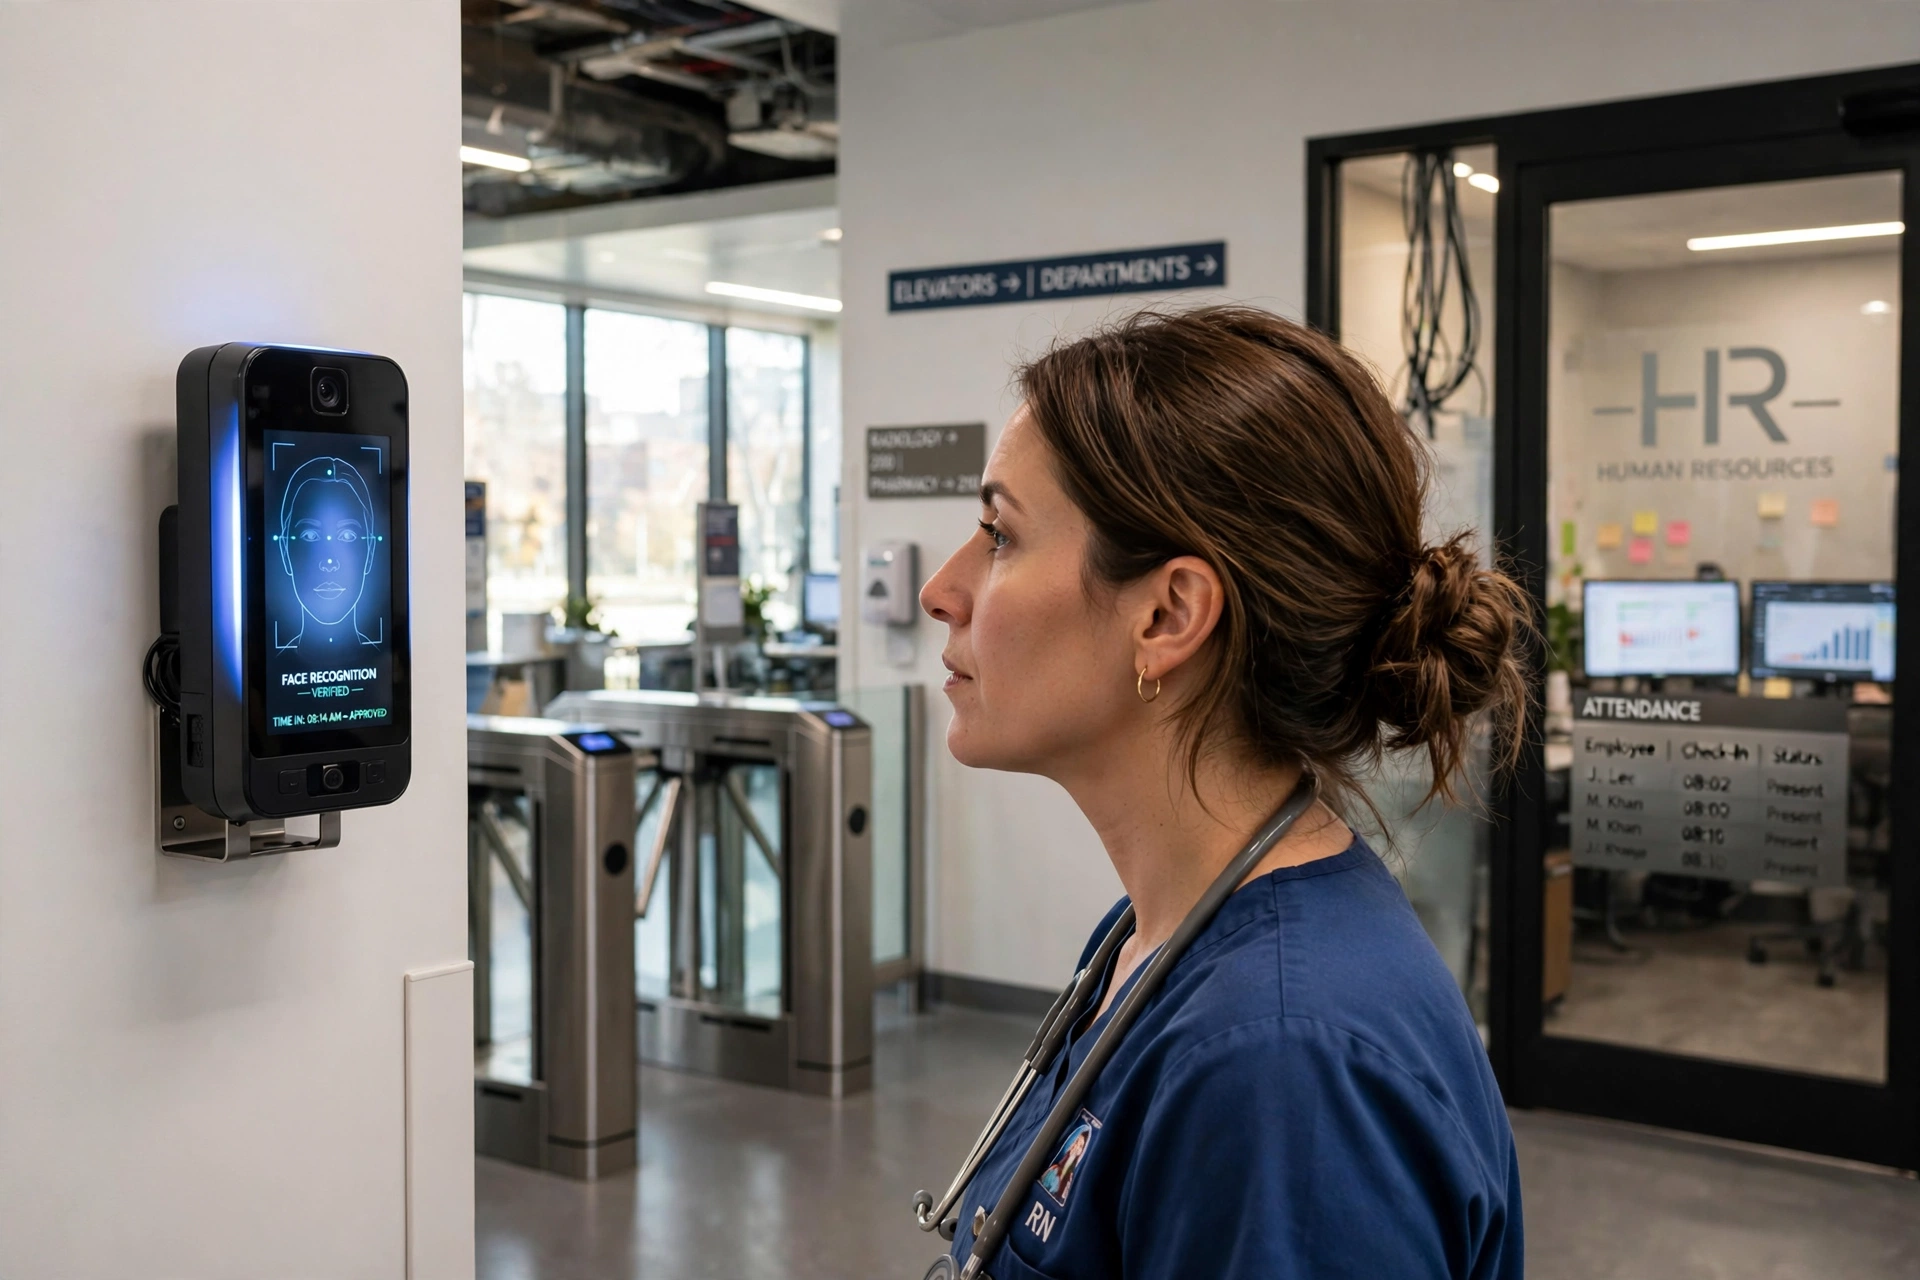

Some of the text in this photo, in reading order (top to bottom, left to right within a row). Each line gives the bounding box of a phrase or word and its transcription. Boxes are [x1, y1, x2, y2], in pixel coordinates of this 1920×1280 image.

[893, 255, 1191, 304] ELEVATORS DEPARTMENTS
[1597, 456, 1834, 483] HUMAN RESOURCES
[281, 667, 377, 686] FACE RECOGNITION
[311, 685, 350, 698] VERIFIED
[273, 715, 293, 727] TIME
[294, 715, 305, 726] IN:
[307, 713, 328, 725] 08:14
[329, 711, 342, 723] AM
[349, 708, 387, 721] APPROVED
[1582, 697, 1701, 722] ATTENDANCE
[1585, 737, 1656, 759] Employee
[1767, 777, 1824, 799] Present
[1608, 794, 1644, 811] Khan
[1766, 805, 1822, 825] Present
[1607, 819, 1642, 836] Khan
[1764, 831, 1818, 851] Present
[1024, 1200, 1057, 1244] RN
